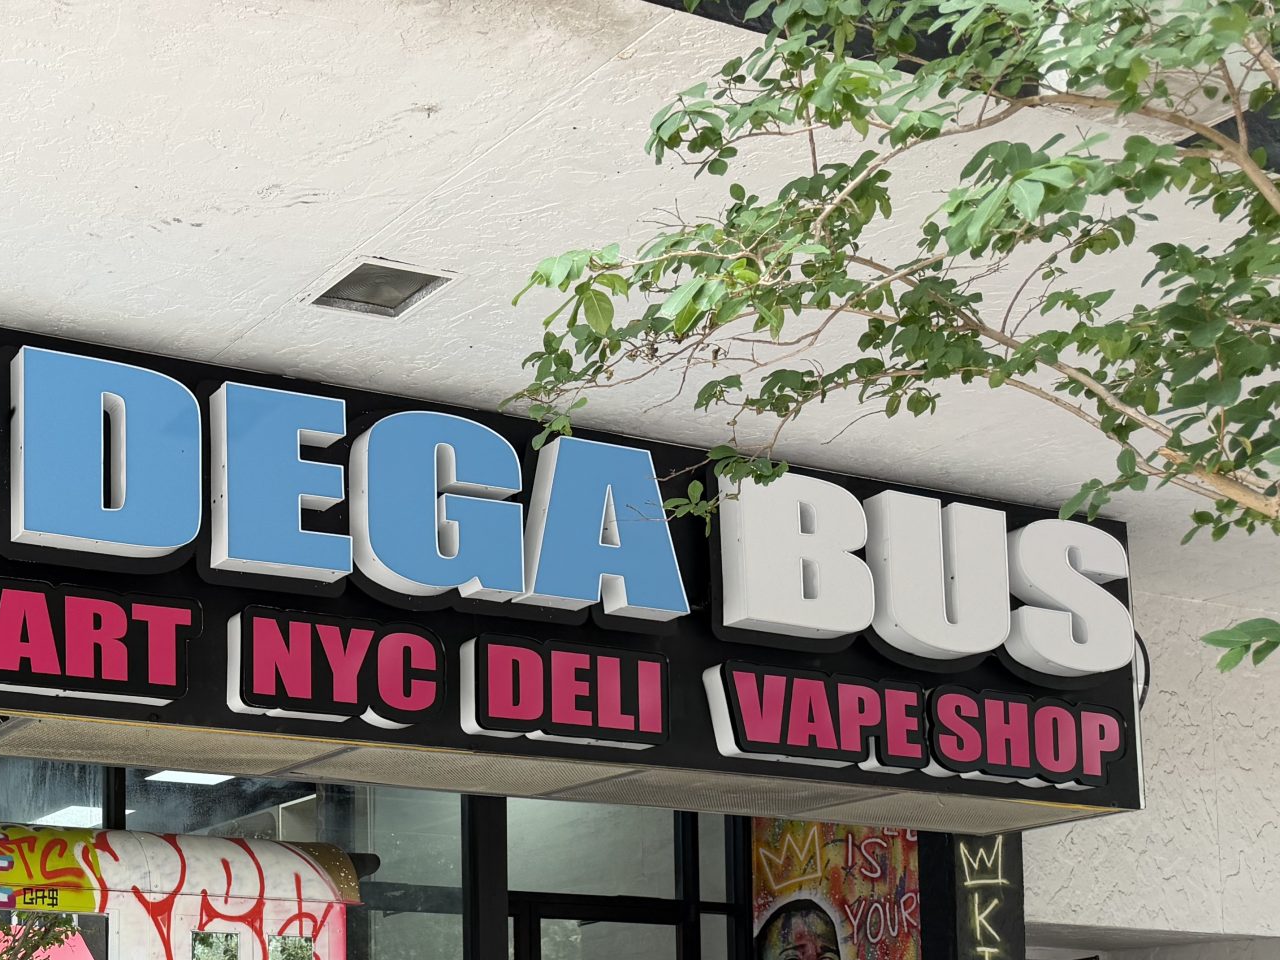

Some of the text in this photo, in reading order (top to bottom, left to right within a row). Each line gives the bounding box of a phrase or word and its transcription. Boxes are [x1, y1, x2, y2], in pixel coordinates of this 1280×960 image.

[718, 468, 1136, 678] BUS
[251, 615, 437, 711] NYC
[486, 642, 662, 734] DELI
[731, 670, 921, 758] VAPE
[937, 694, 1120, 777] SHOP
[847, 833, 888, 878] IS
